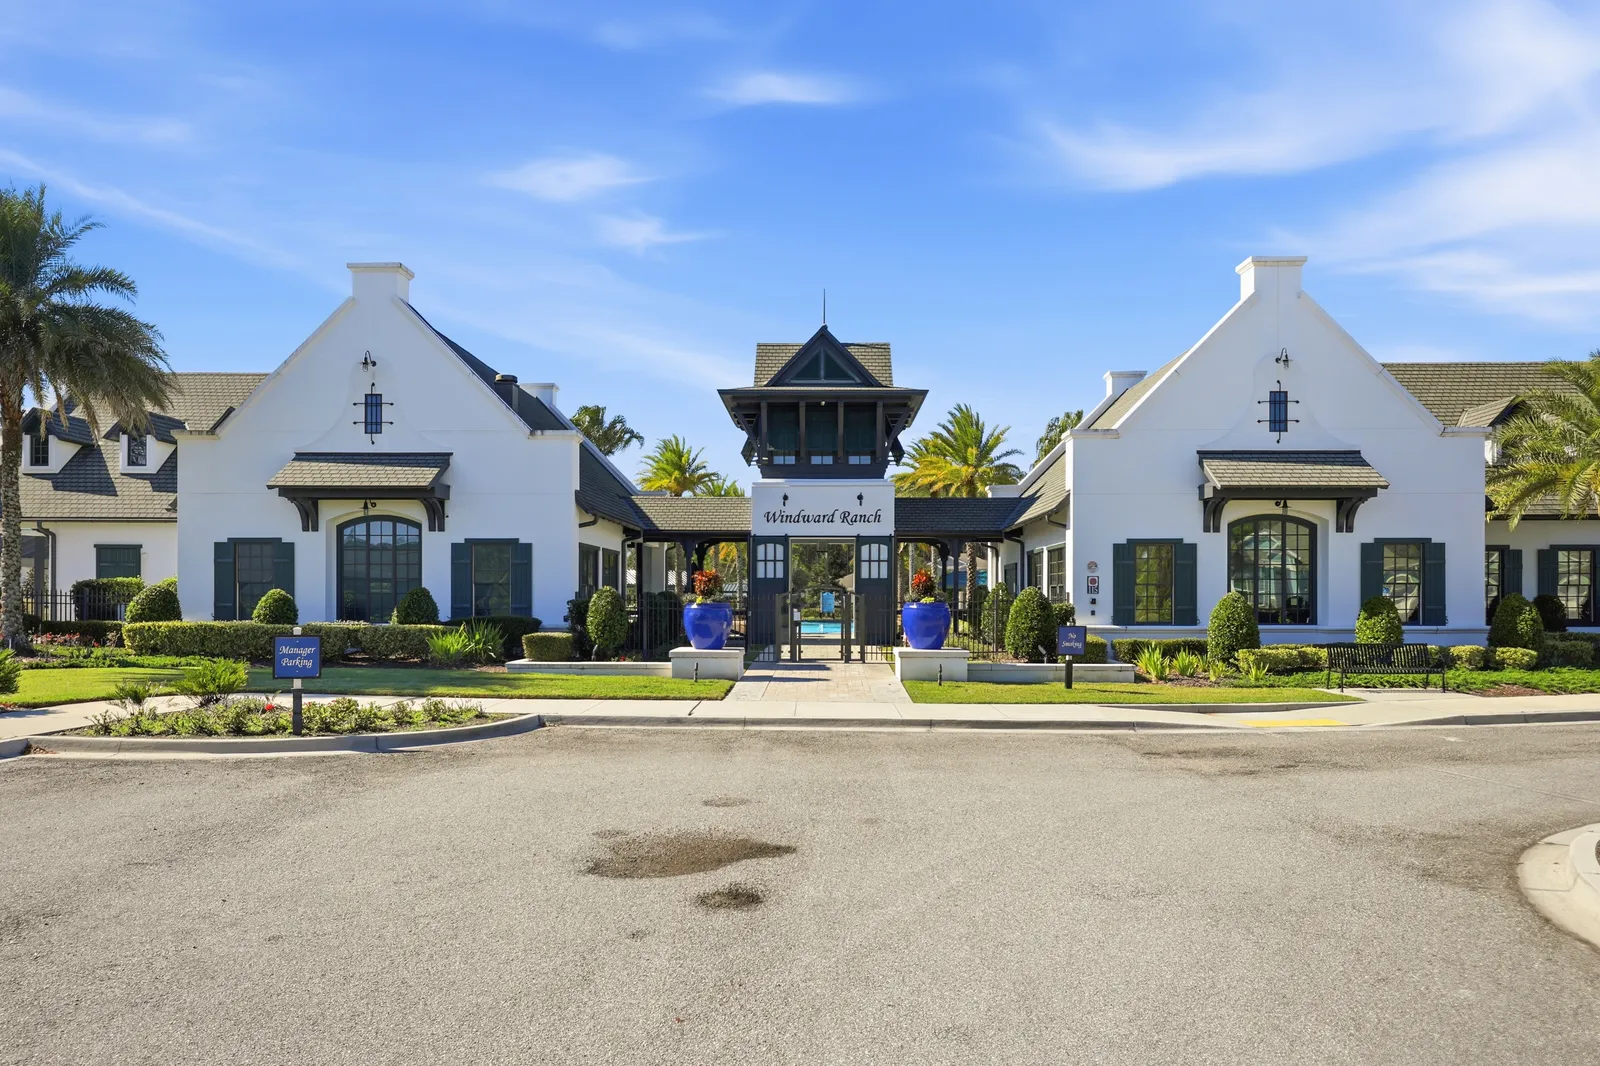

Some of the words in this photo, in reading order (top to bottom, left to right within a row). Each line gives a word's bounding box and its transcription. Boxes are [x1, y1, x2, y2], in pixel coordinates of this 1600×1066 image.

[764, 509, 839, 524] Windward
[840, 509, 881, 526] Ranch
[1061, 641, 1082, 649] Smoking
[279, 645, 316, 657] Manager
[281, 657, 313, 668] Parking
